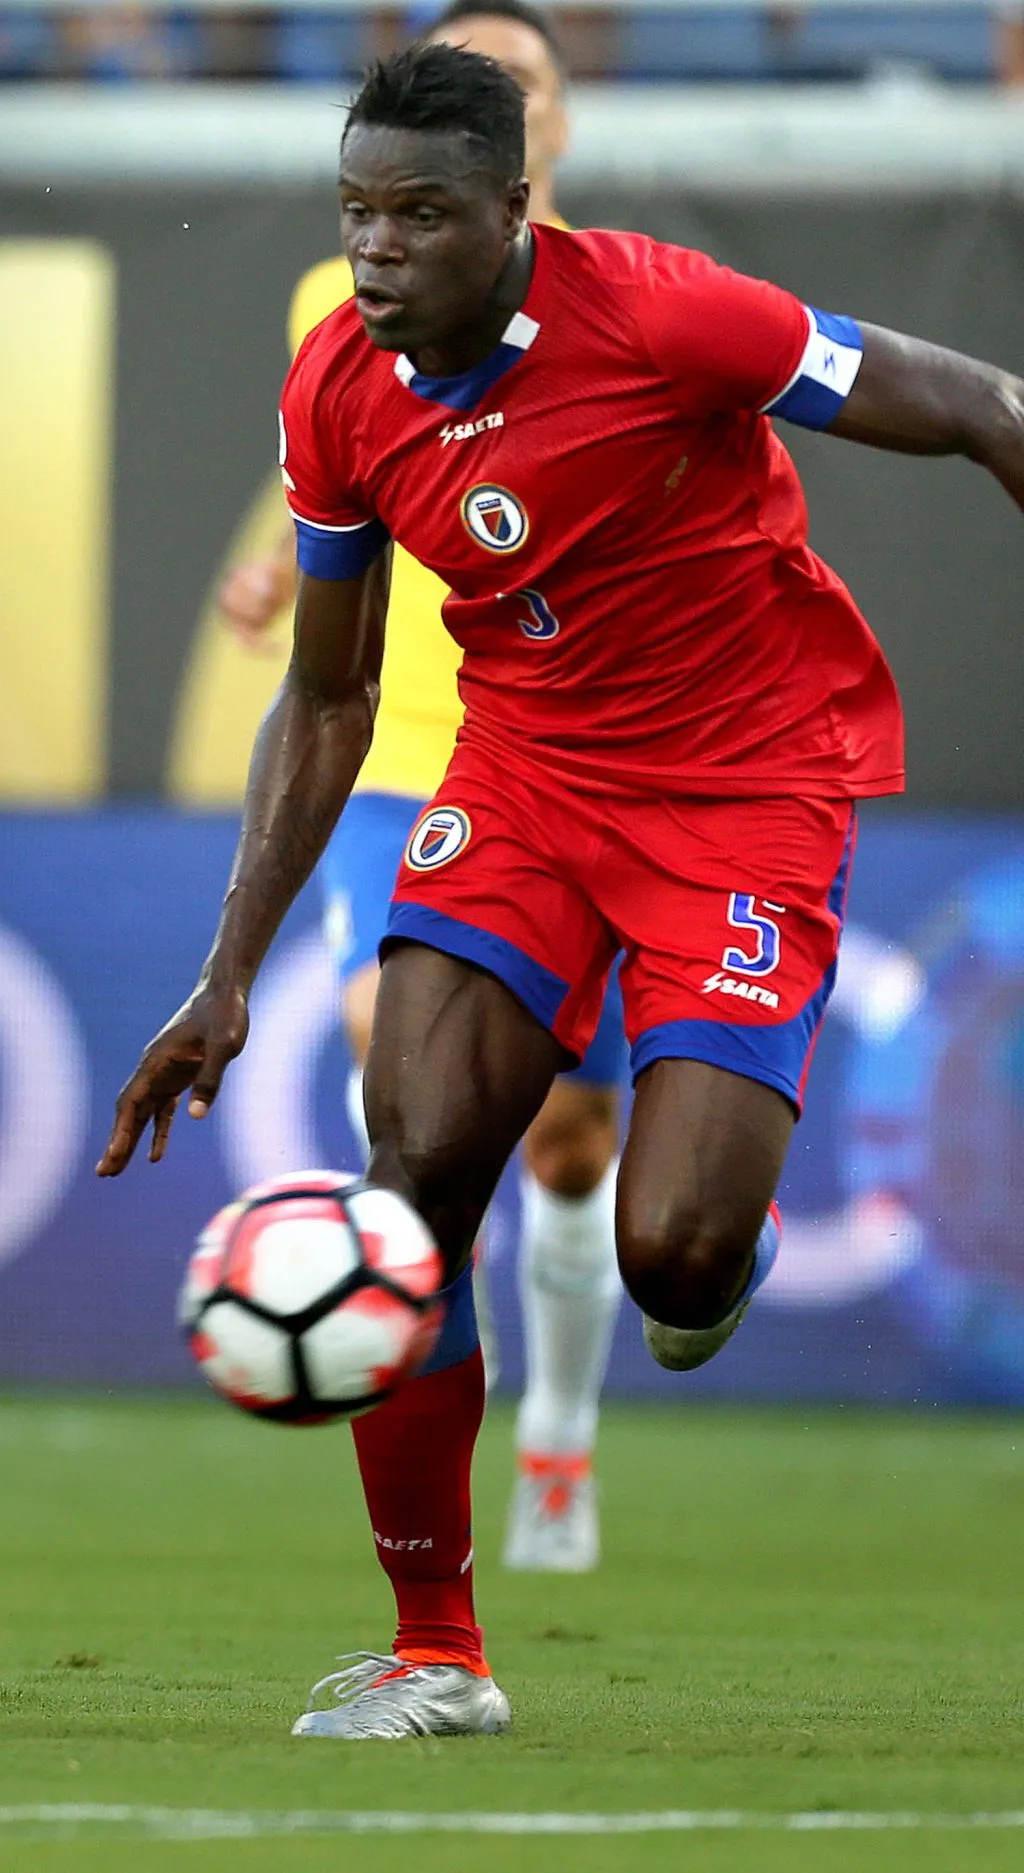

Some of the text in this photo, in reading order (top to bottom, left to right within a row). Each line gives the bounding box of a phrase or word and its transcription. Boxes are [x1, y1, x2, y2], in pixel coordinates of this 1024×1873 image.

[453, 411, 505, 441] SAETA
[722, 892, 785, 977] 5
[719, 977, 780, 1009] SAETA
